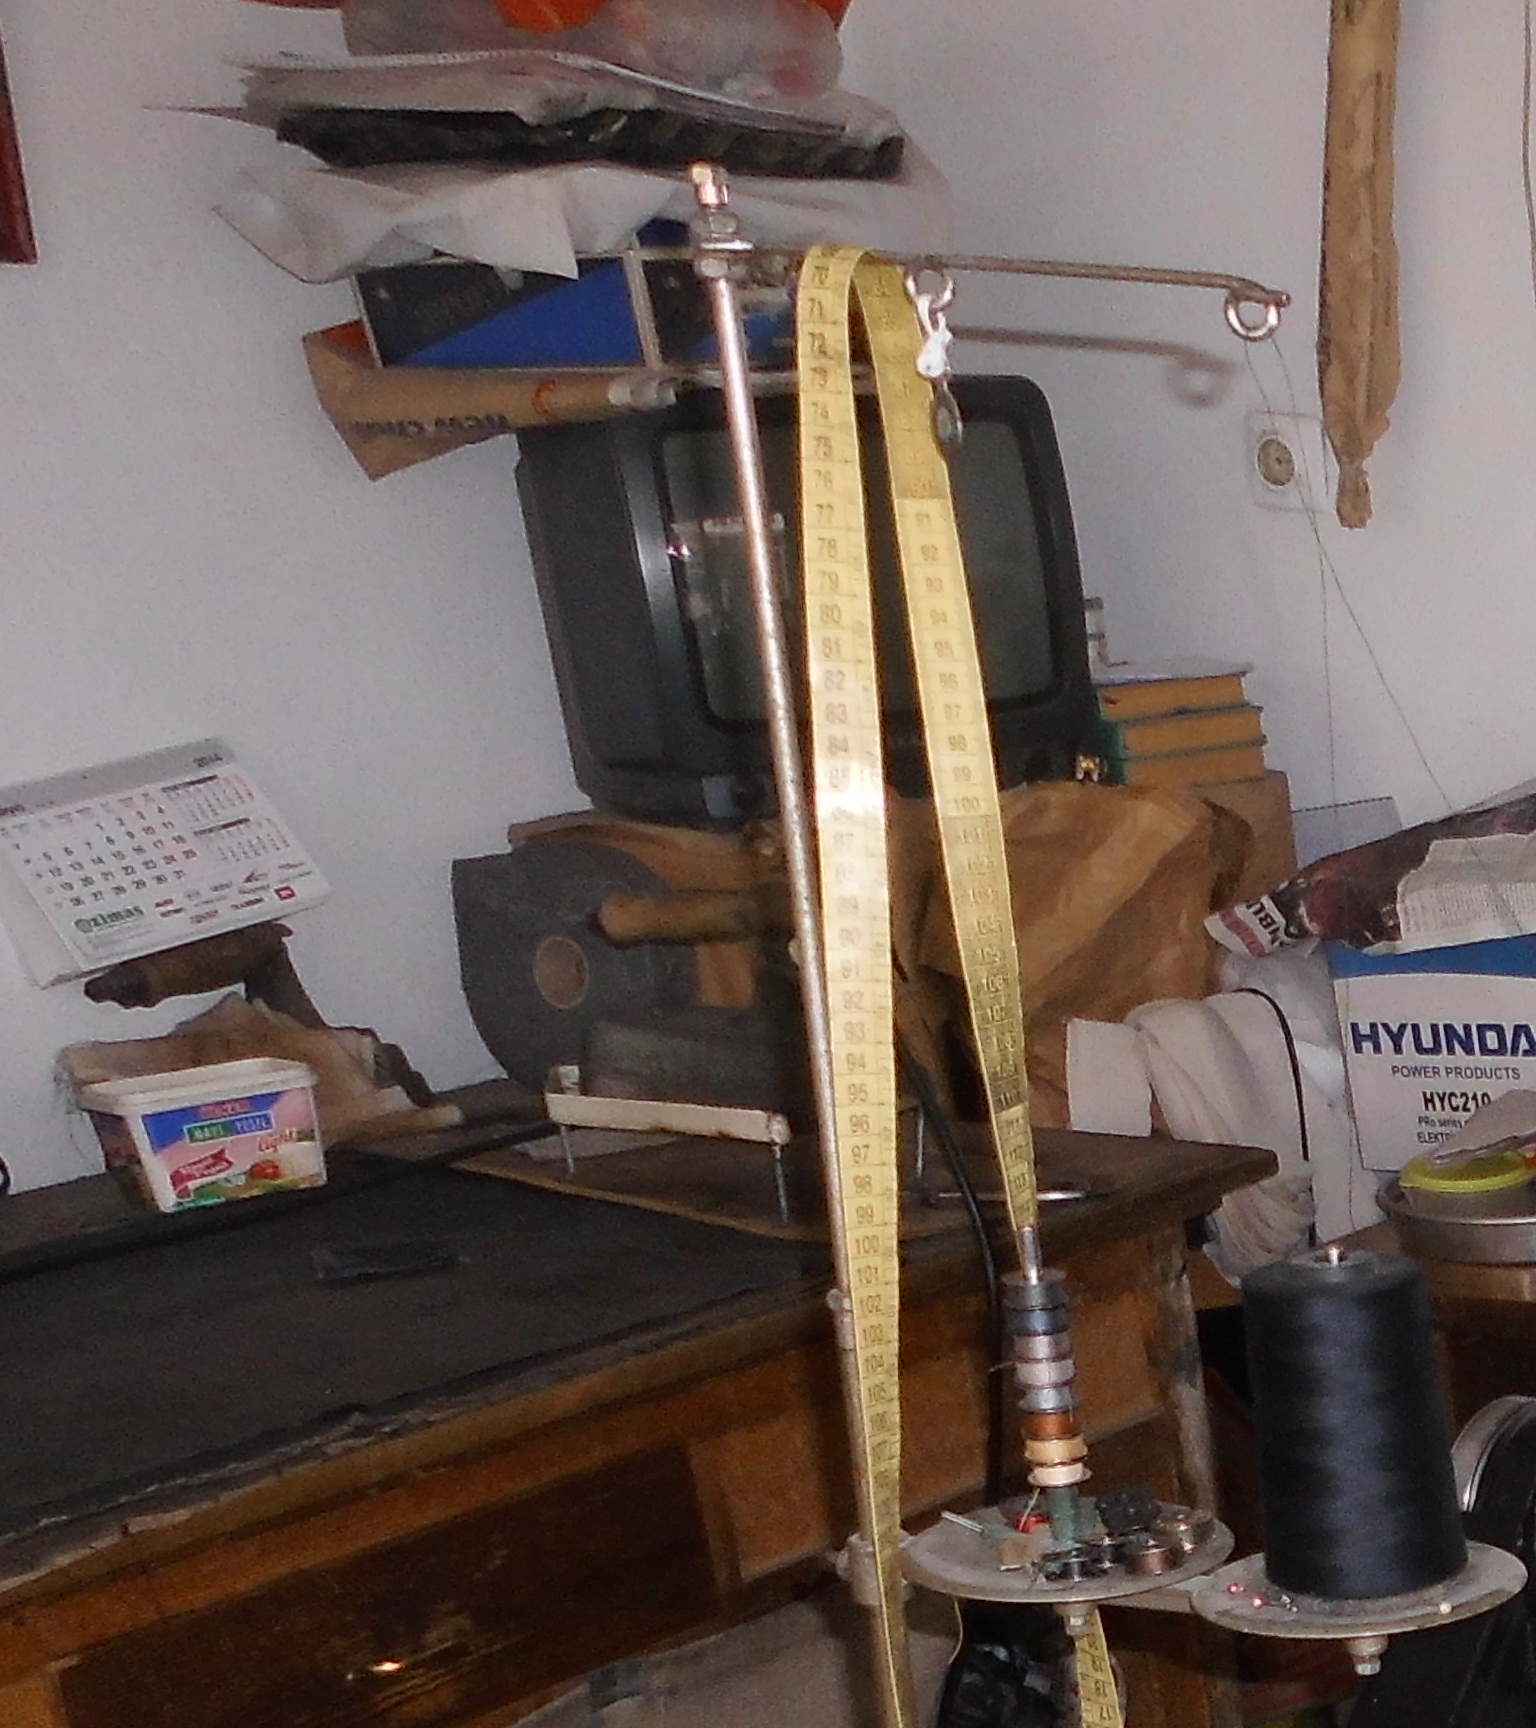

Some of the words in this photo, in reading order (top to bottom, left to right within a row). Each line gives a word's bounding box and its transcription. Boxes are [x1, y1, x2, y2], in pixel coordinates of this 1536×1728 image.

[808, 298, 823, 318] 71
[808, 332, 828, 354] 72
[1391, 1065, 1441, 1079] POWER
[1445, 1066, 1521, 1080] PRODUCTS
[1099, 1705, 1114, 1721] 17
